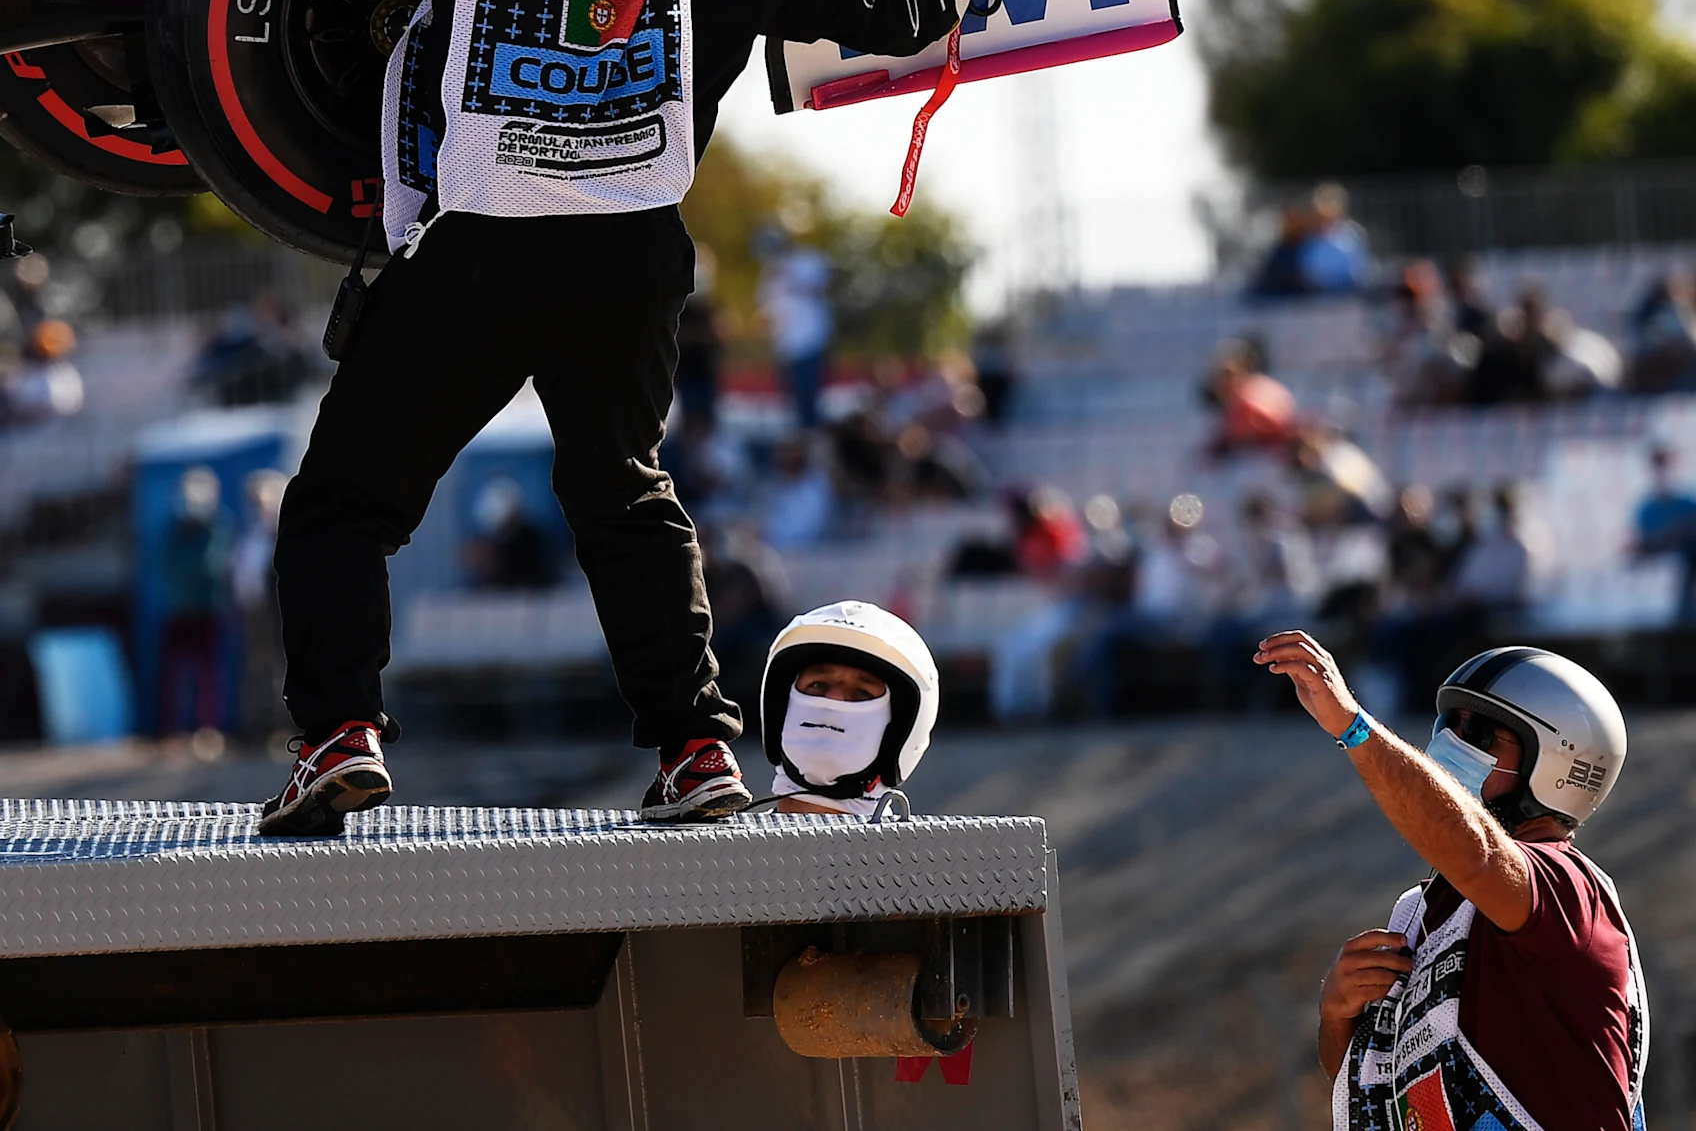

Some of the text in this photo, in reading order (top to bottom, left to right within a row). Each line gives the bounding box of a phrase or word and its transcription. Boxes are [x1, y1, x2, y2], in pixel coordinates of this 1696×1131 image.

[499, 131, 573, 149] FORMULA
[604, 128, 656, 146] PREMIO
[497, 142, 581, 160] DE PORTUG
[496, 155, 534, 167] 2020
[1401, 1023, 1434, 1059] SERVICE
